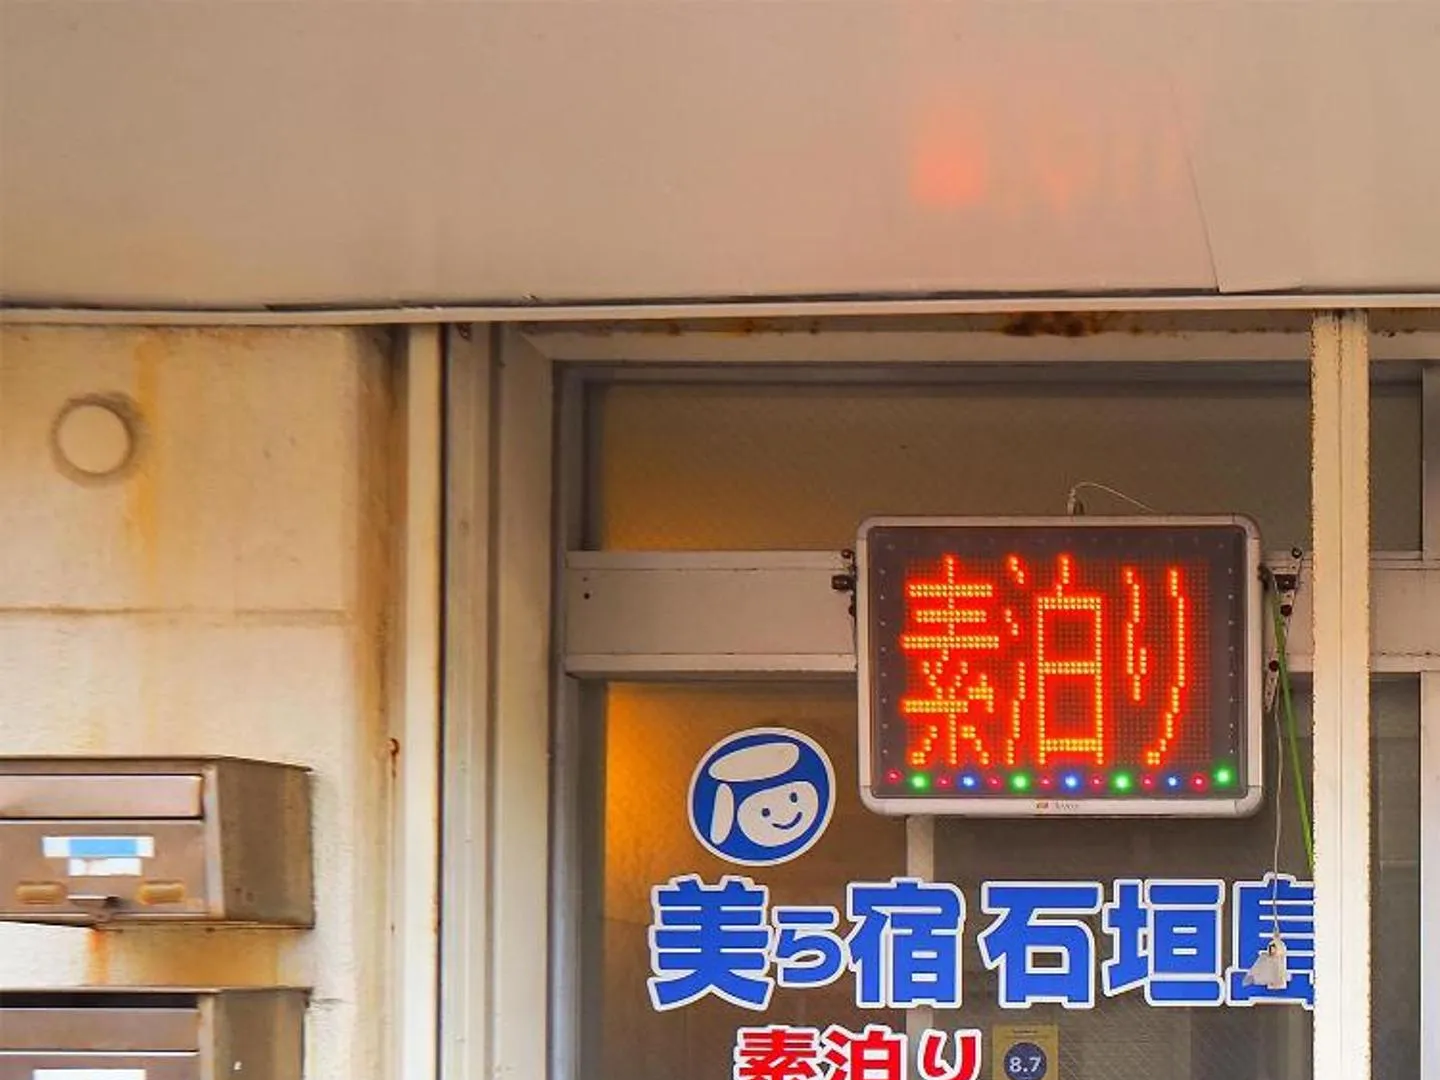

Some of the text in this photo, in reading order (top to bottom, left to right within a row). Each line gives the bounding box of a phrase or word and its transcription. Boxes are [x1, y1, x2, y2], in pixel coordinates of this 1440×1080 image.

[902, 554, 1186, 766] 素泊り
[1009, 1056, 1042, 1073] 8.7
